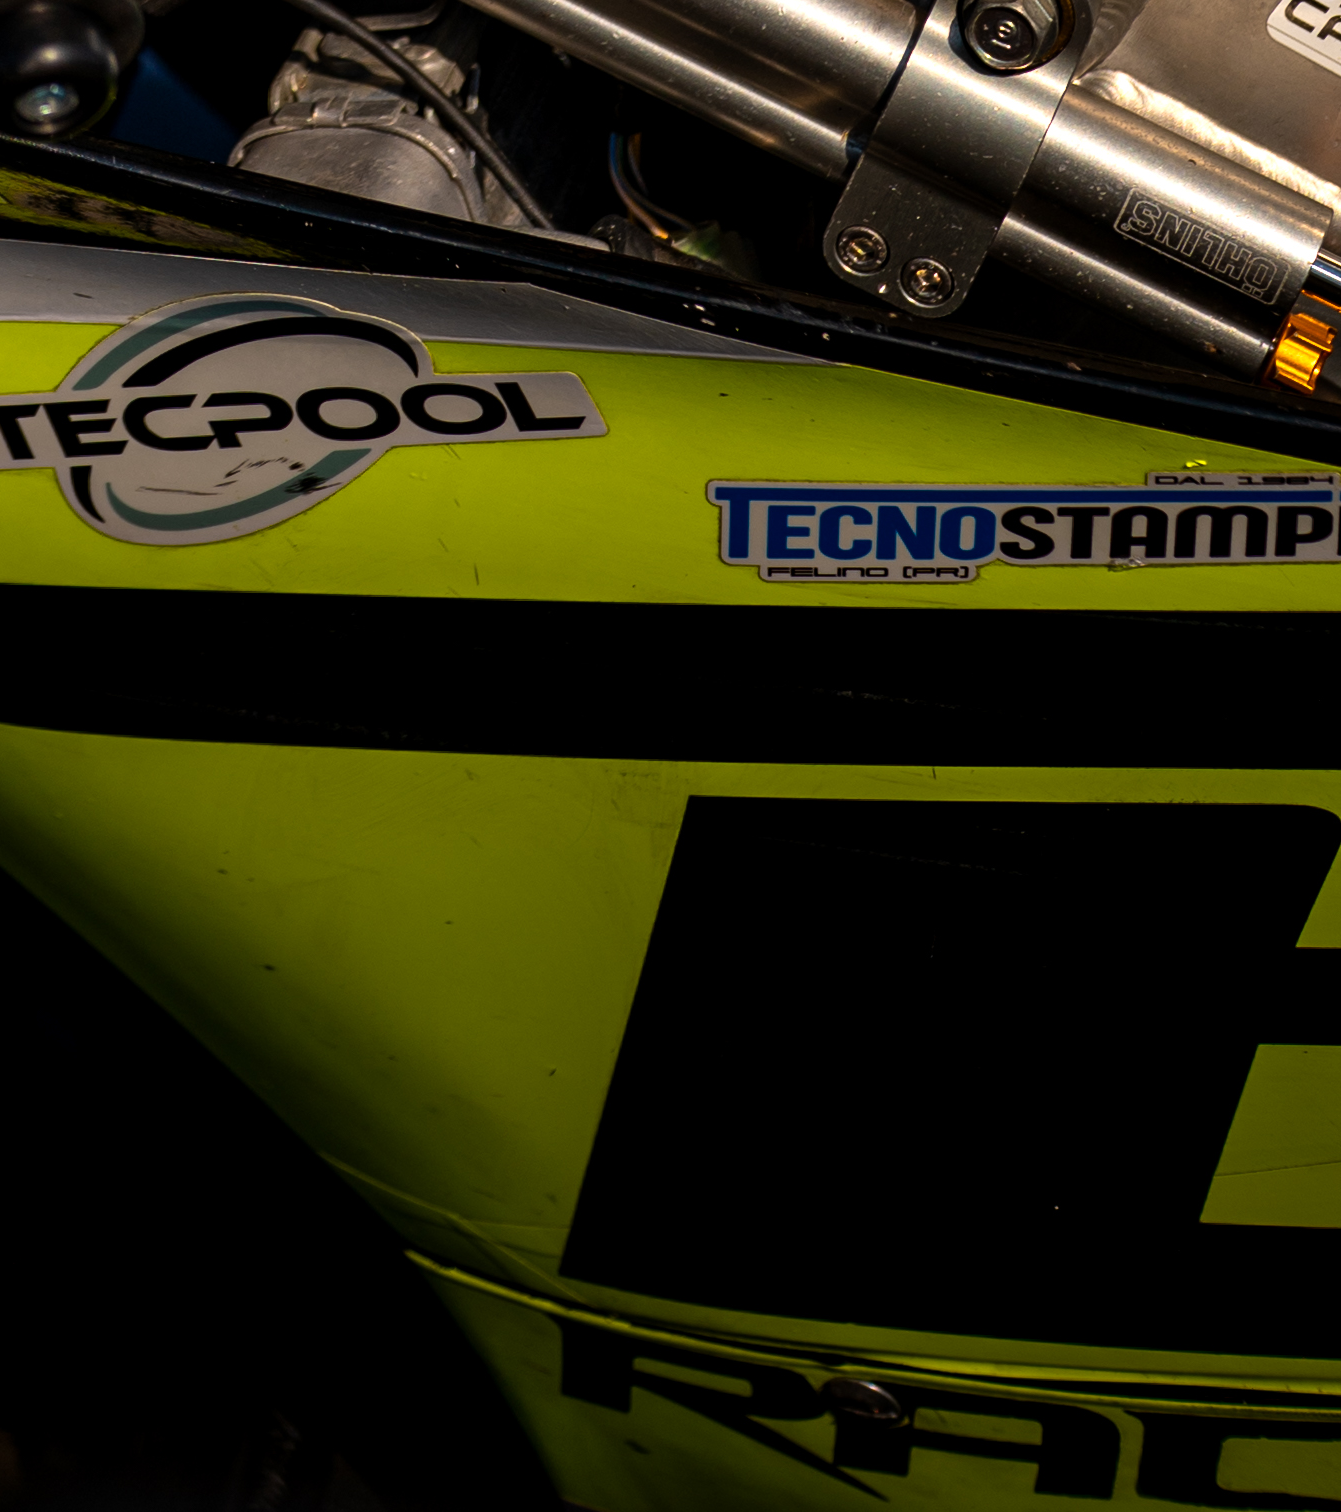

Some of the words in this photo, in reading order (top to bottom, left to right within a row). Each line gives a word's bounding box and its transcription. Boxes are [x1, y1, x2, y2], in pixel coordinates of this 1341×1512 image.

[1153, 475, 1225, 487] DAL
[1236, 475, 1335, 486] 1984
[767, 566, 890, 579] FELINO
